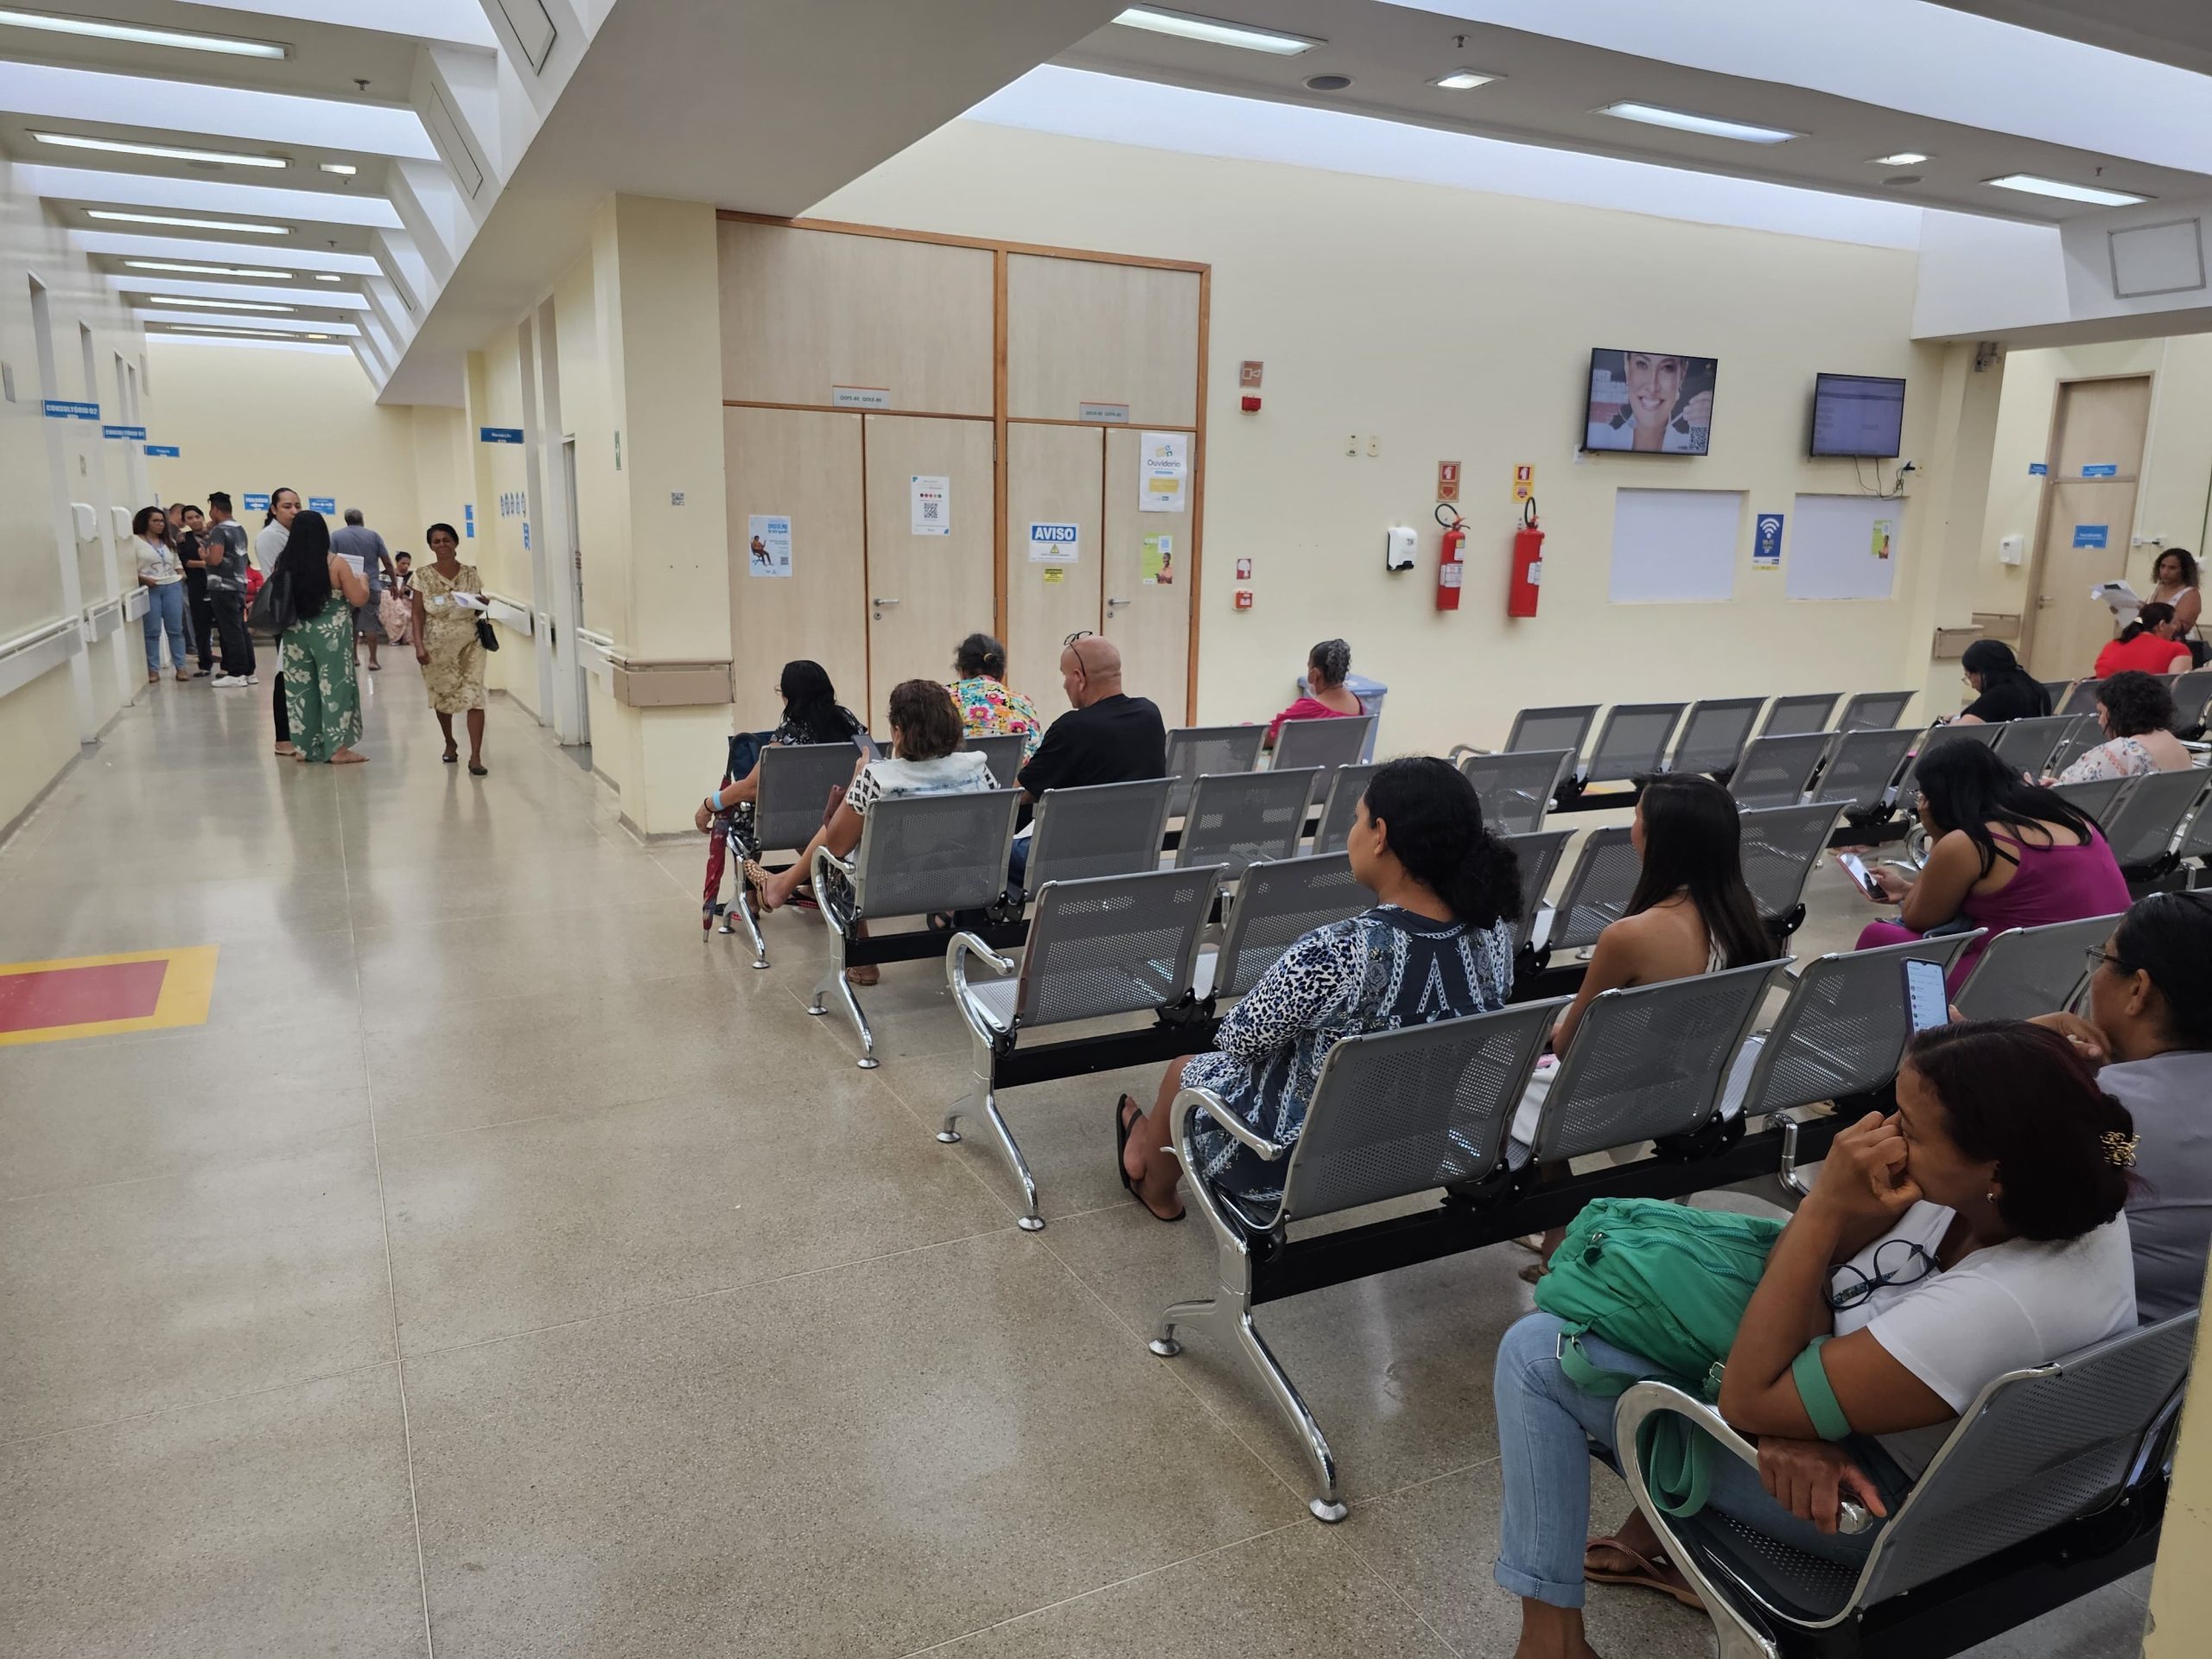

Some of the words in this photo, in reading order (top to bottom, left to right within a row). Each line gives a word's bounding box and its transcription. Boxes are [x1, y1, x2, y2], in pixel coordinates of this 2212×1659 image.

[46, 404, 88, 414] CONSULTÓRIO
[1147, 459, 1181, 467] Ouvidoria
[1034, 526, 1075, 541] AVISO
